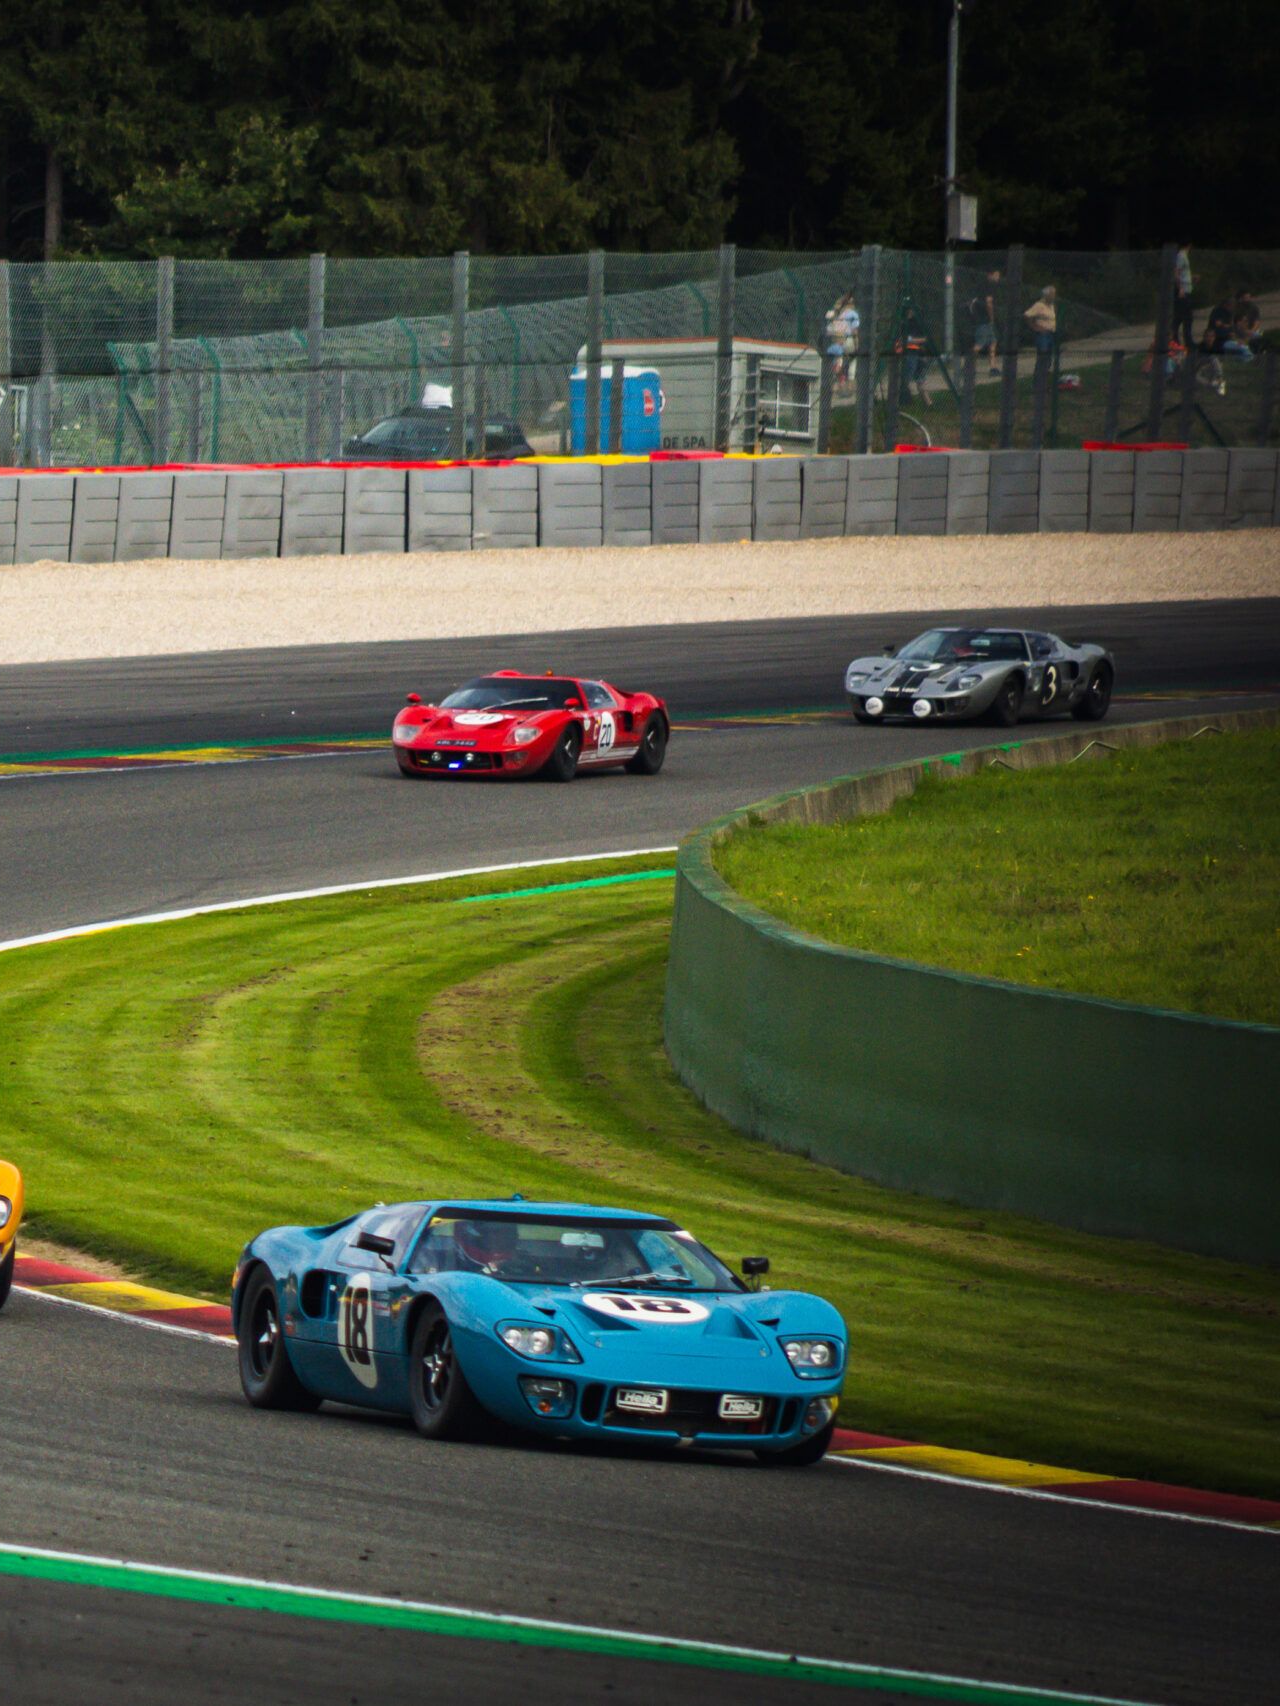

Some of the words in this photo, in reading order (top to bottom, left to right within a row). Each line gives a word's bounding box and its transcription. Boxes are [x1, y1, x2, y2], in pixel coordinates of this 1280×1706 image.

[663, 436, 679, 449] DE
[683, 436, 705, 448] SPA
[1042, 666, 1057, 705] 3
[600, 723, 612, 748] 20
[600, 1296, 691, 1314] 18
[345, 1286, 371, 1366] 18
[624, 1391, 658, 1405] Hella
[728, 1401, 756, 1412] Hella
